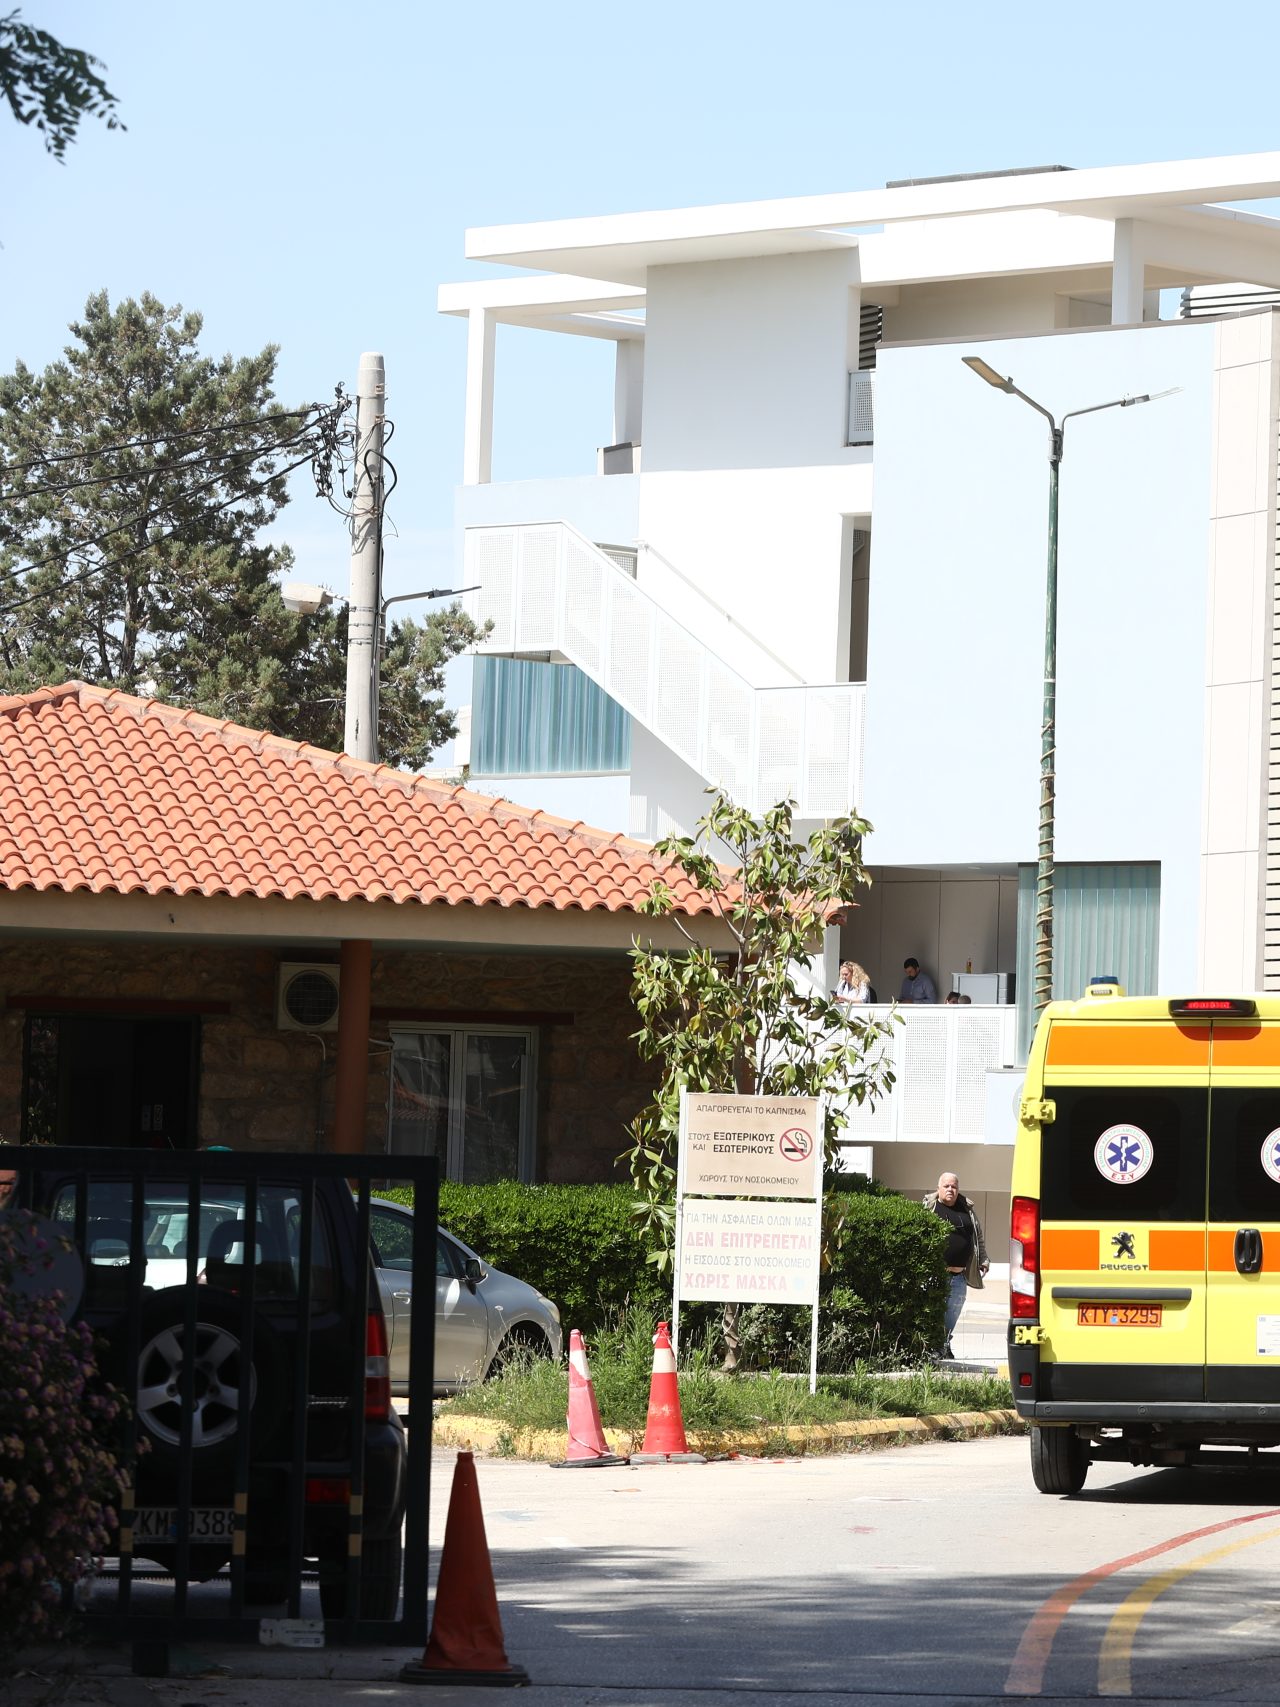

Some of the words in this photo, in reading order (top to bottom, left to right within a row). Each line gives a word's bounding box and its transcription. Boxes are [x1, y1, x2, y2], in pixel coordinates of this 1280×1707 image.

[696, 1104, 752, 1114] ΑΠΑΓΟΡΕΥΕΤΑΙ
[755, 1106, 764, 1114] ΤΟ
[766, 1107, 807, 1115] ΚΑΠΝΙΣΜΑ
[688, 1133, 711, 1141] ΣΤΟΥΣ
[713, 1132, 775, 1142] ΕΞΩΤΕΡΙΚΟΥΣ
[693, 1143, 706, 1151] ΚΑΙ
[713, 1144, 775, 1154] ΕΣΩΤΕΡΙΚΟΥΣ
[699, 1174, 728, 1183] ΧΩΡΟΥΣ
[730, 1175, 744, 1183] ΤΟΥ
[745, 1176, 799, 1185] ΝΟΣΟΚΟΜΕΙΟΥ
[686, 1213, 699, 1223] ΓΙΑ
[702, 1213, 718, 1224] ΤΗΝ
[722, 1214, 764, 1225] ΑΣΦΑΛΕΙΑ
[767, 1216, 791, 1226] ΟΛΩΝ
[795, 1217, 813, 1227] ΜΑΣ
[686, 1232, 714, 1247] ΔΕΝ
[721, 1232, 812, 1250] ΕΠΙΤΡΕΠΕΤΑΙ
[685, 1254, 691, 1265] Η
[694, 1255, 731, 1266] ΕΙΣΟΔΟΣ
[734, 1256, 751, 1267] ΣΤΟ
[754, 1257, 811, 1268] ΝΟΣΟΚΟΜΕΙΟ
[685, 1273, 730, 1289] ΧΩΡΙΣ
[737, 1275, 787, 1291] ΜΑΣΚΑ
